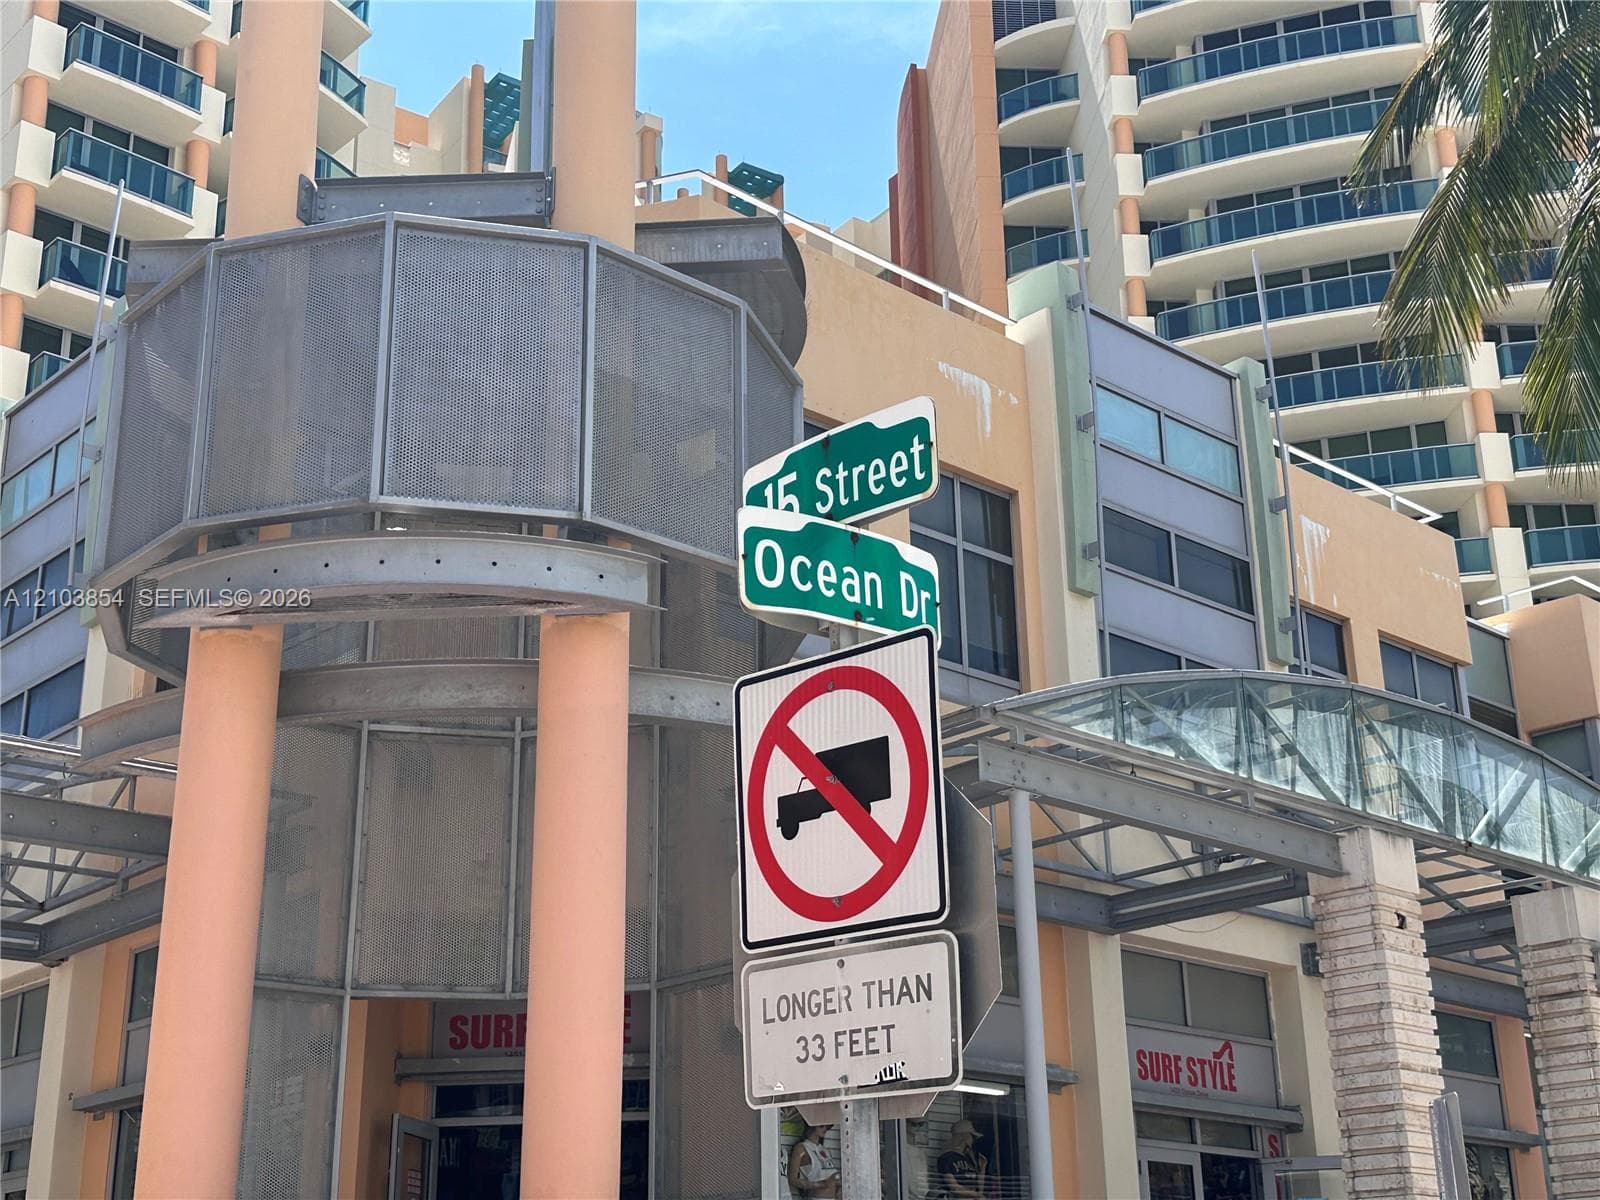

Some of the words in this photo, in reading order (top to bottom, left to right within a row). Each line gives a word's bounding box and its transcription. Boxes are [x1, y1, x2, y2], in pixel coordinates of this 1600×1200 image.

[764, 471, 800, 513] 15
[815, 434, 926, 514] Street
[754, 539, 883, 610] Ocean
[899, 570, 931, 624] Dr
[762, 984, 853, 1025] LONGER
[861, 972, 933, 1009] THAN
[795, 1034, 826, 1064] 33
[834, 1024, 896, 1060] FEET
[1136, 1048, 1182, 1084] SURF
[1186, 1055, 1238, 1093] STYLE
